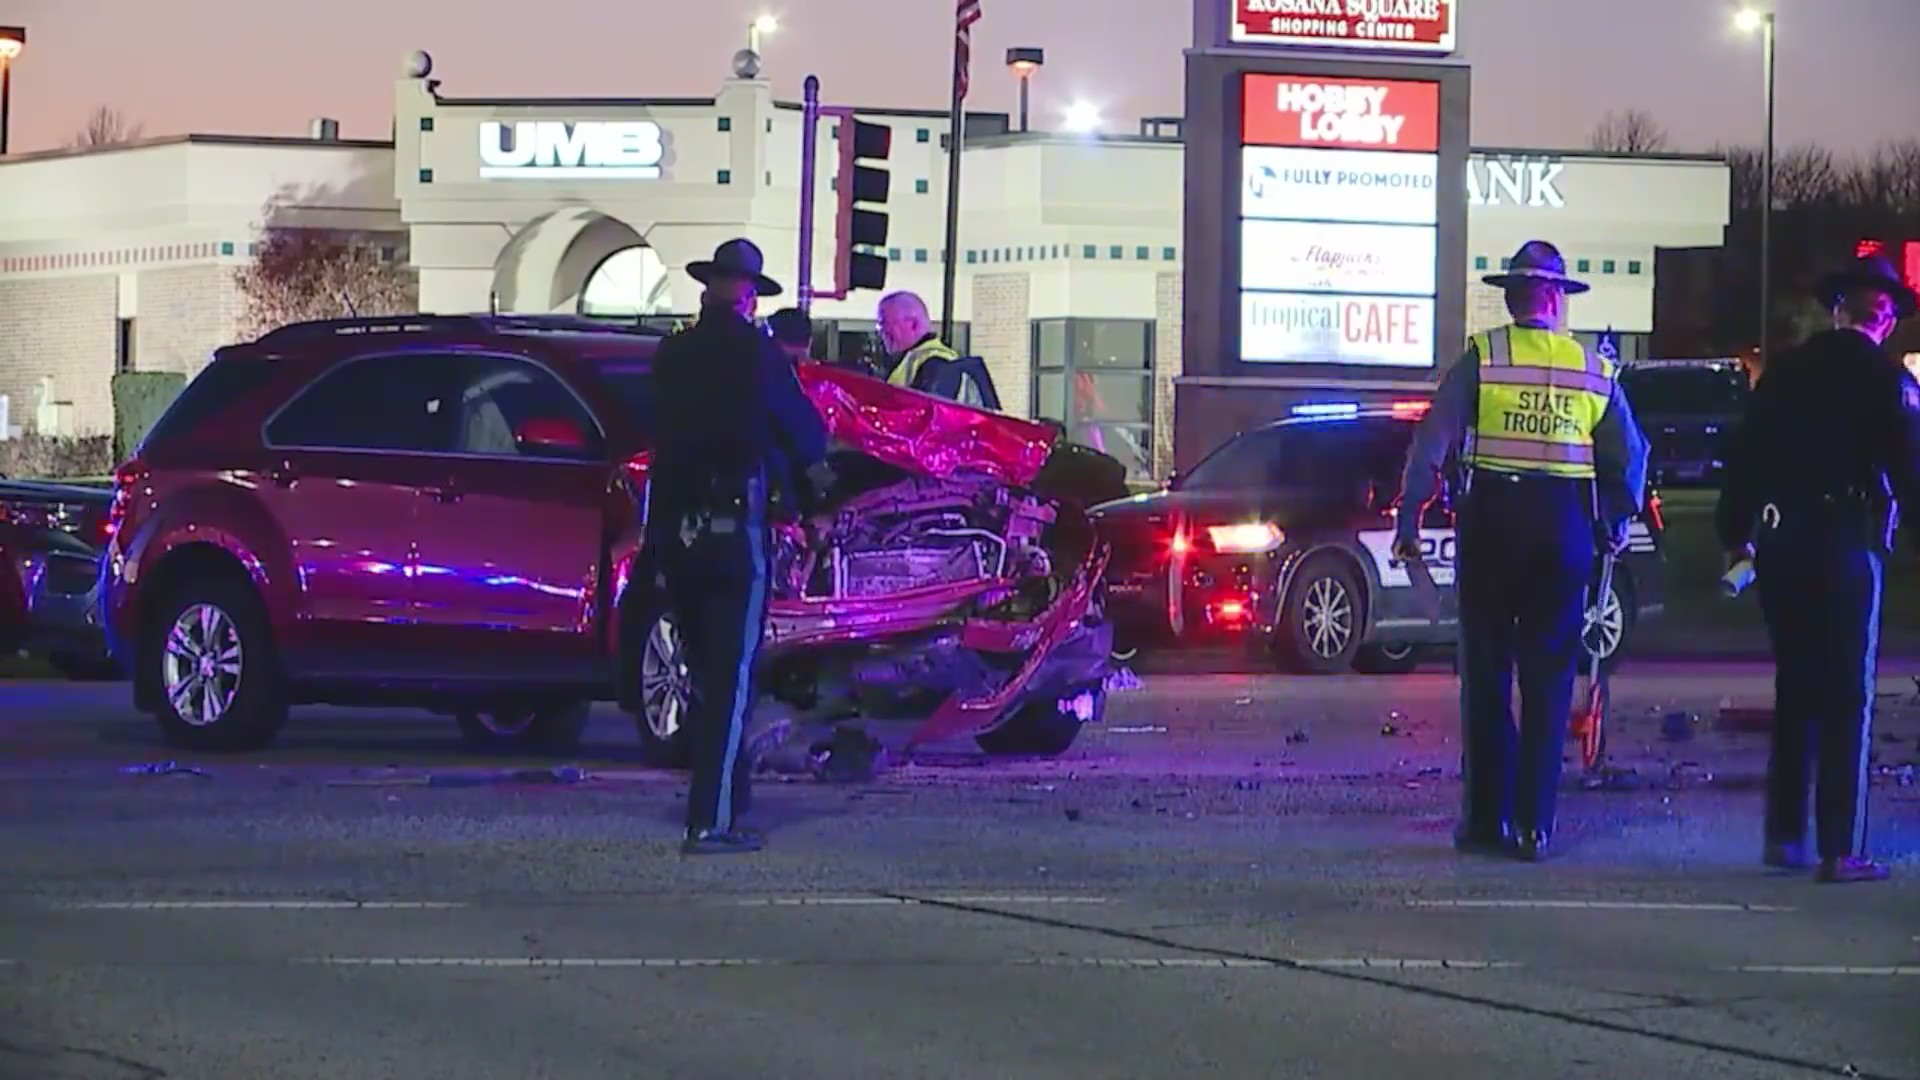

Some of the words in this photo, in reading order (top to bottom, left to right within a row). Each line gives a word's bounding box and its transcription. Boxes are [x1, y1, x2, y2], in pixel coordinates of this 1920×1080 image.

[1248, 0, 1341, 16] ROSANA
[1347, 0, 1440, 21] SQUARE
[1271, 17, 1348, 36] SHOPPING
[1355, 22, 1415, 40] CENTER
[1276, 83, 1389, 116] HOBBY
[1301, 112, 1406, 144] LOBBY
[479, 120, 663, 167] UMB
[1284, 168, 1332, 185] FULLY
[1337, 171, 1433, 189] PROMOTED
[1466, 159, 1565, 207] ANK
[1344, 301, 1421, 345] CAFE
[1518, 391, 1574, 415] STATE
[1503, 411, 1584, 436] TROOPER
